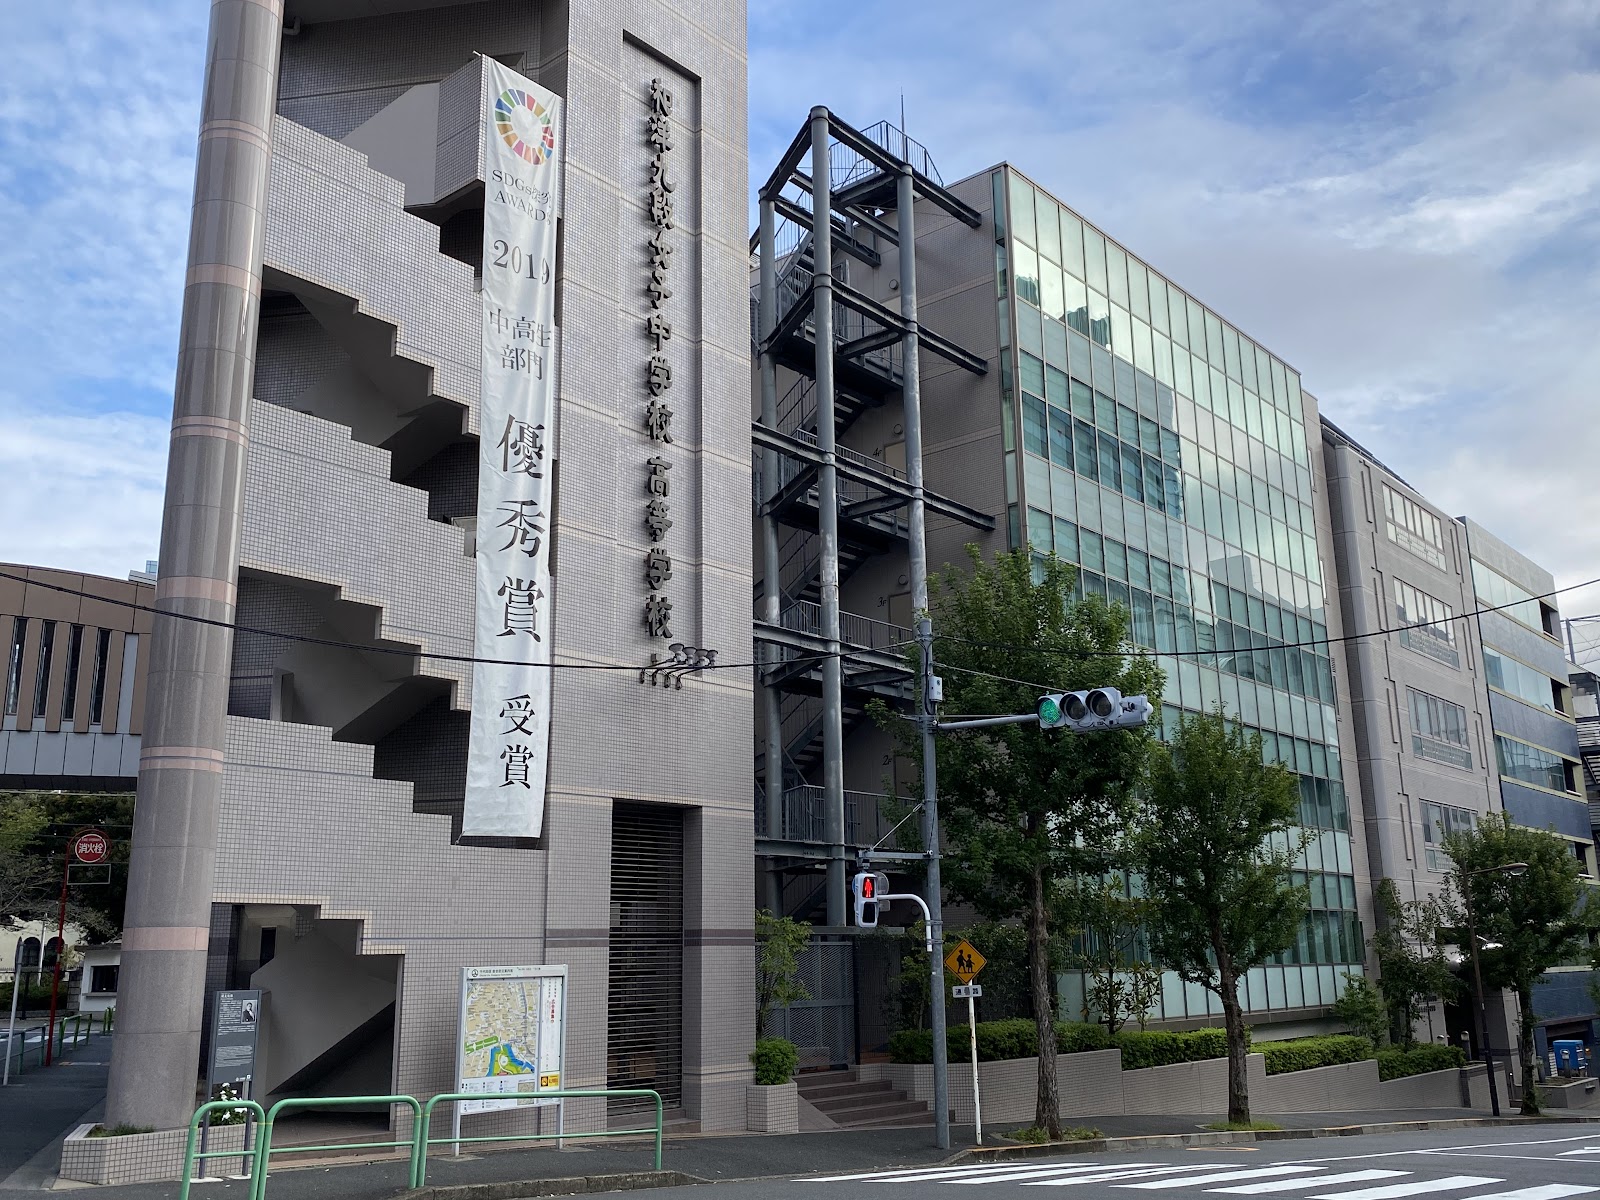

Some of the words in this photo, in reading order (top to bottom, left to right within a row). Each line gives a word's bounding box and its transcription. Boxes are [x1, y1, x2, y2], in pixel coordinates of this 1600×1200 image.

[493, 239, 550, 285] 2019
[647, 78, 676, 444] 和洋九段女子中学校
[489, 308, 551, 347] 中高生
[500, 343, 543, 380] 部門
[496, 414, 545, 643] 優秀賞
[646, 456, 673, 638] 高等学校
[877, 596, 887, 608] 3F
[499, 694, 534, 789] 受賞
[882, 755, 892, 766] 2F
[79, 842, 104, 854] 消火栓
